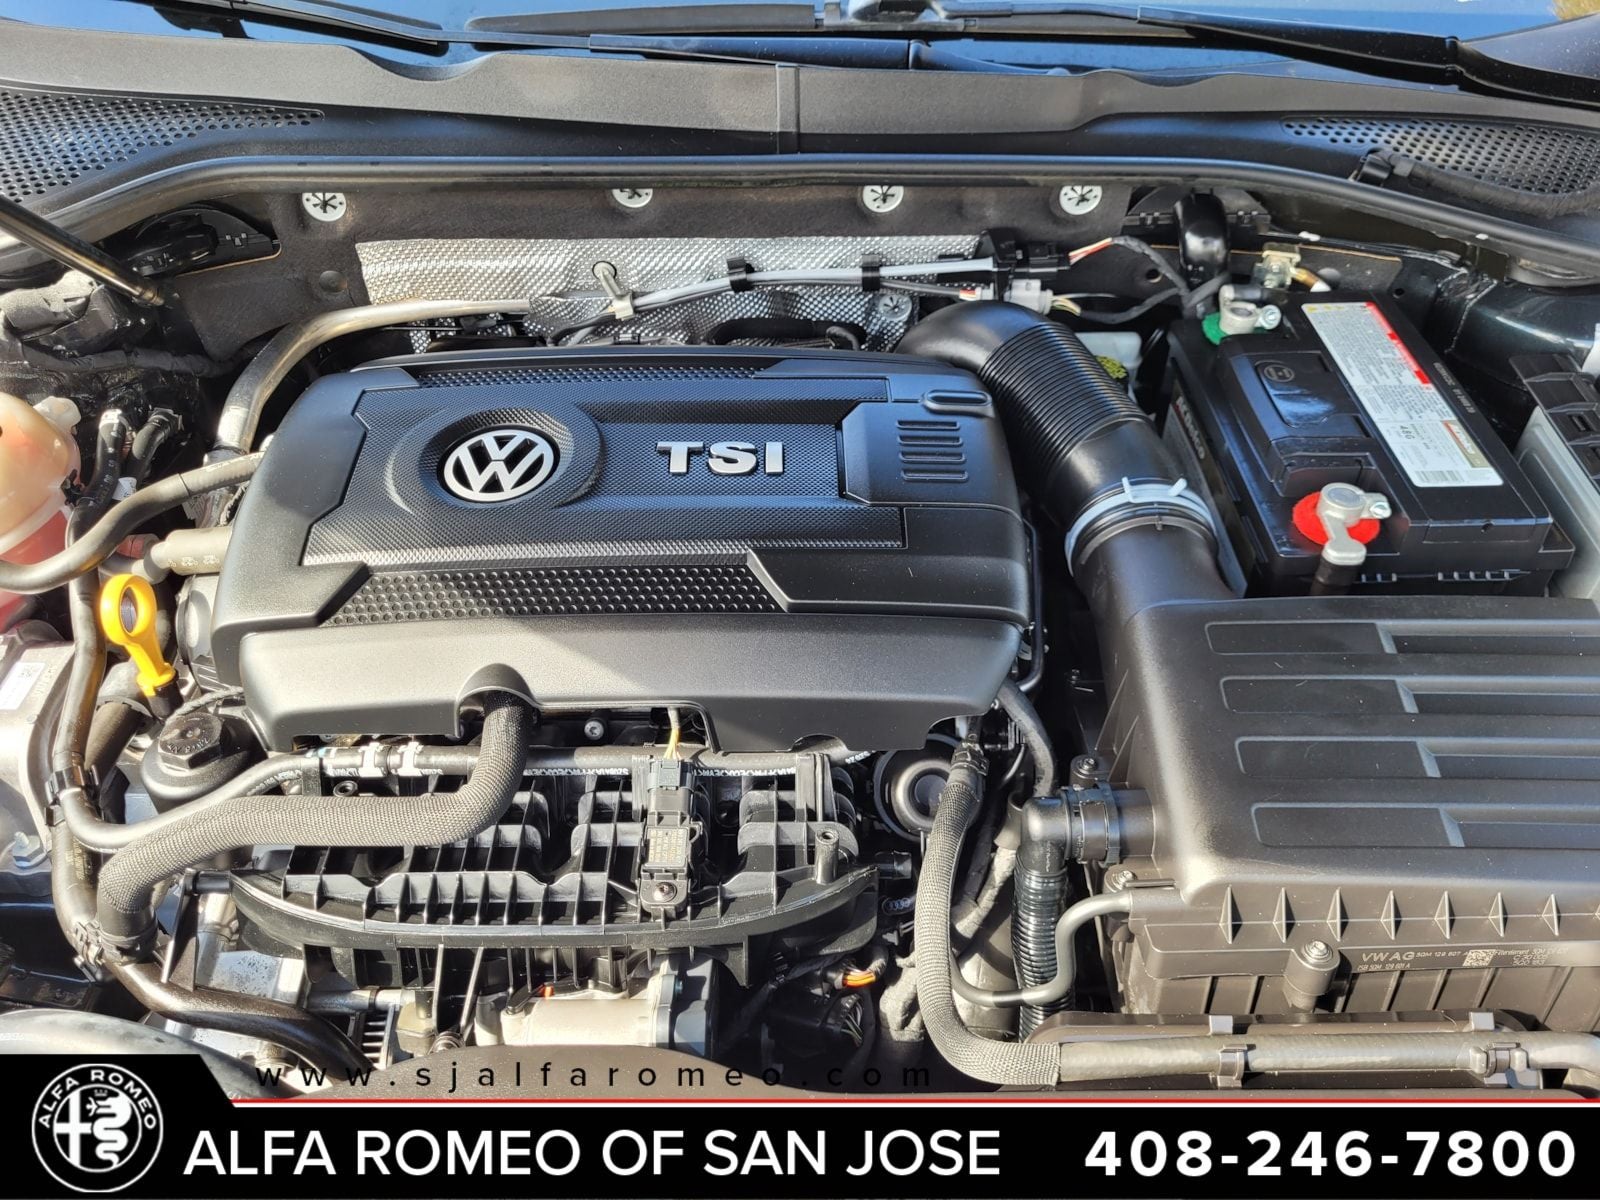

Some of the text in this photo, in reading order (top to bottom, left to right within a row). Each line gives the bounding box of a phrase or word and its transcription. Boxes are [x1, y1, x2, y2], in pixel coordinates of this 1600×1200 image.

[656, 441, 784, 475] TSI
[1361, 952, 1390, 962] VW
[1389, 951, 1415, 961] AG
